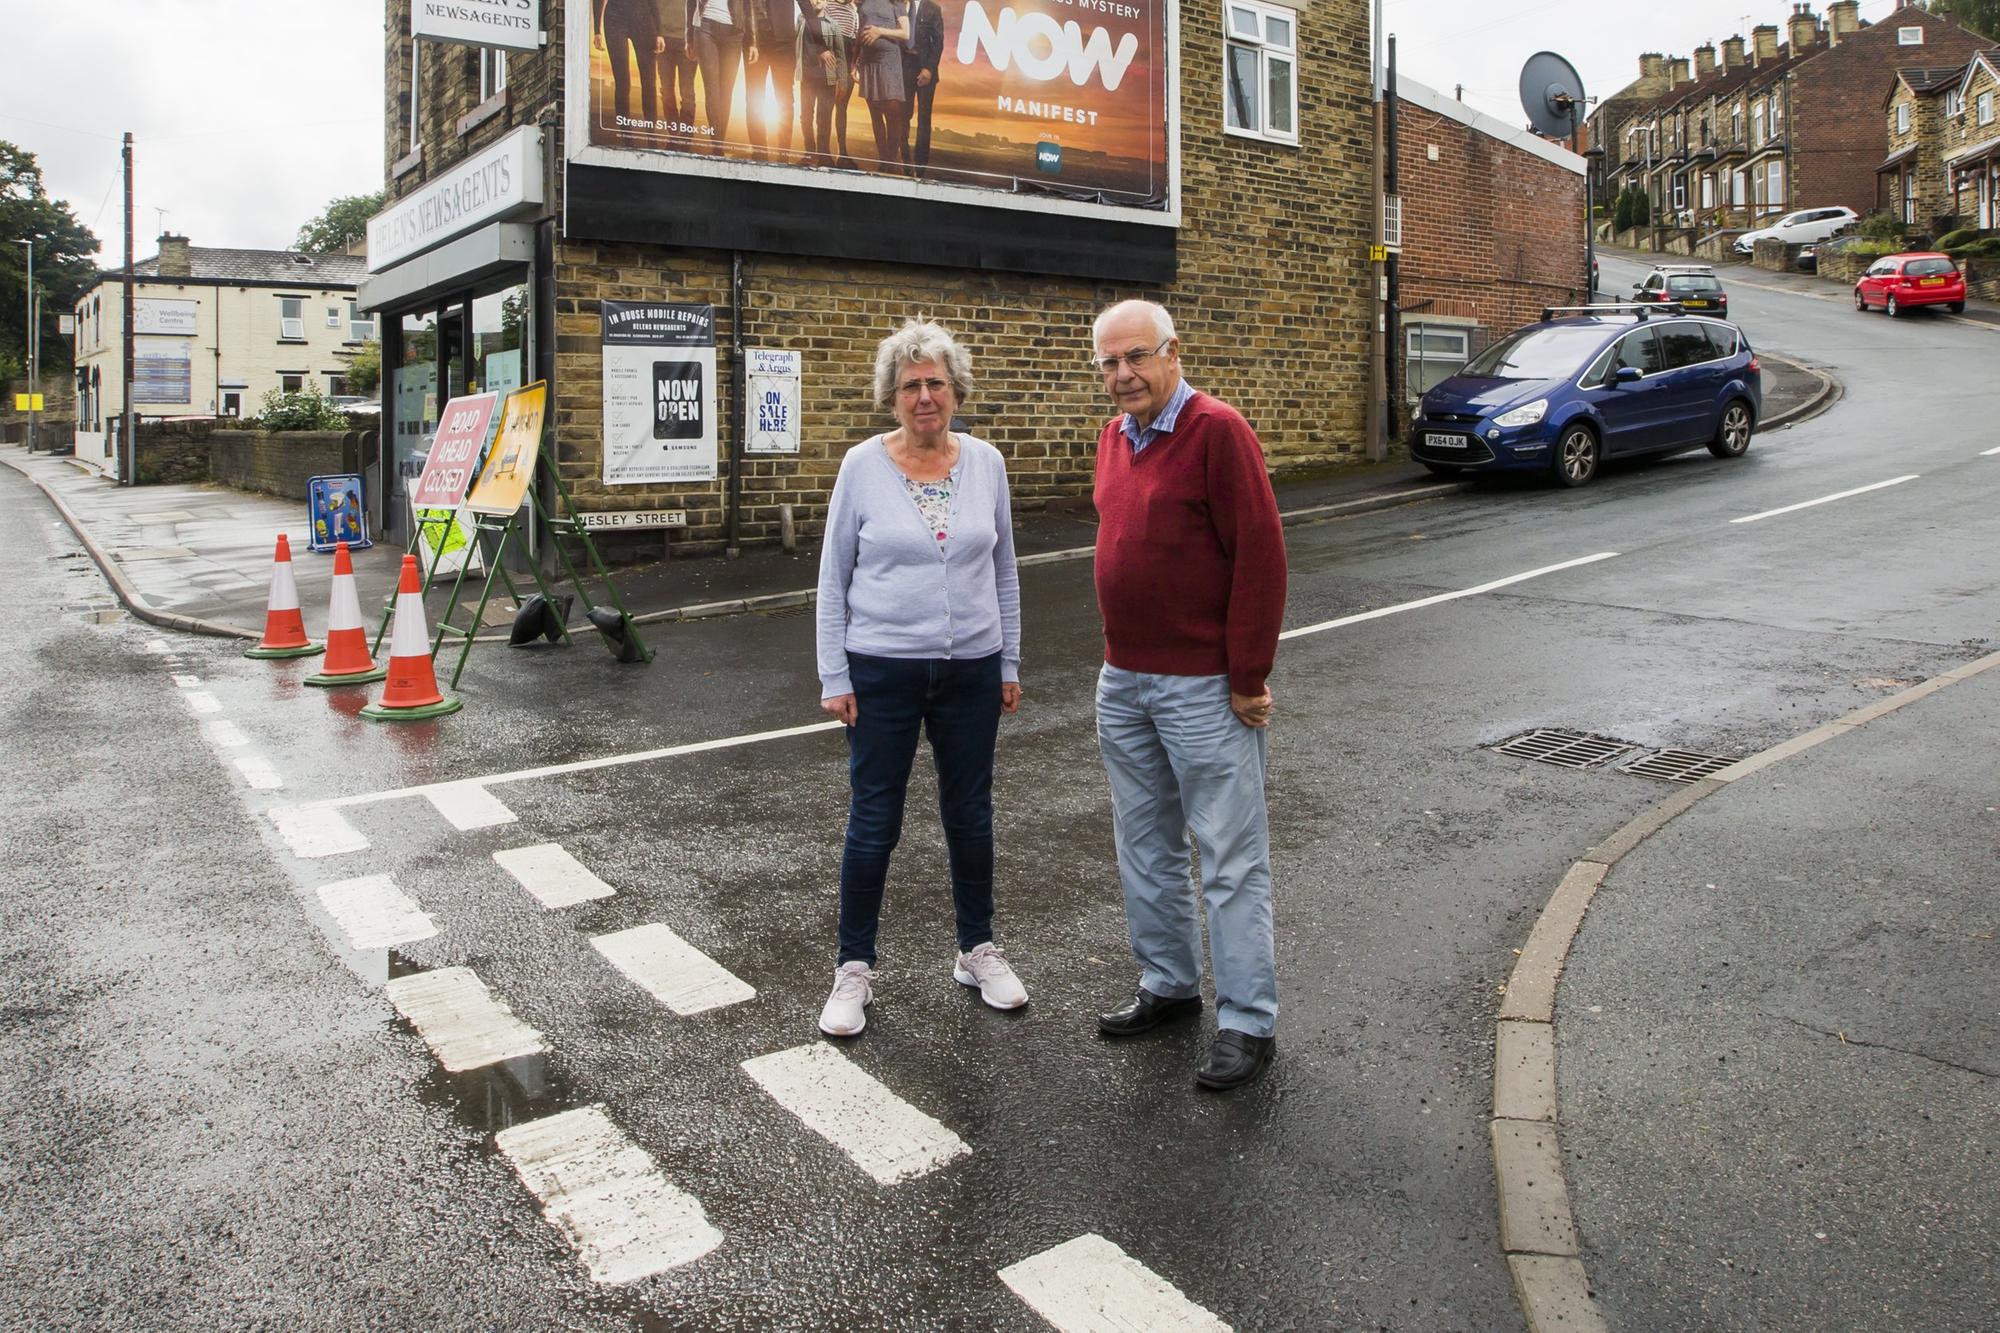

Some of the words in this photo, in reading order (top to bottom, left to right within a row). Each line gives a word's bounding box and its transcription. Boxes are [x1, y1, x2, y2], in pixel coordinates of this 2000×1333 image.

[425, 4, 531, 29] NEWSAGENTS
[1079, 0, 1141, 19] MYSTERY
[957, 0, 1138, 91] NOW
[998, 95, 1098, 126] MANIFEST
[616, 115, 653, 129] Stream
[656, 120, 677, 131] S1-3
[680, 123, 699, 133] Box
[1039, 152, 1059, 162] NOW
[419, 154, 511, 236] NEWSAGENTS
[160, 310, 196, 318] Wellbeing
[608, 313, 619, 325] IN
[620, 309, 645, 322] HOUSE
[647, 309, 676, 320] MOBILE
[677, 311, 709, 328] REPAIRS
[653, 323, 686, 331] NEWSAGENTS
[754, 351, 794, 363] Telegraph
[758, 363, 766, 372] &
[767, 363, 792, 374] Argus
[658, 380, 699, 400] NOW
[766, 392, 780, 405] ON
[658, 401, 699, 420] OPEN
[760, 405, 787, 418] SALE
[449, 410, 480, 433] ROAD
[760, 418, 787, 432] HERE
[437, 439, 472, 462] AHEAD
[424, 468, 465, 492] CLOSED
[635, 513, 682, 524] STREET
